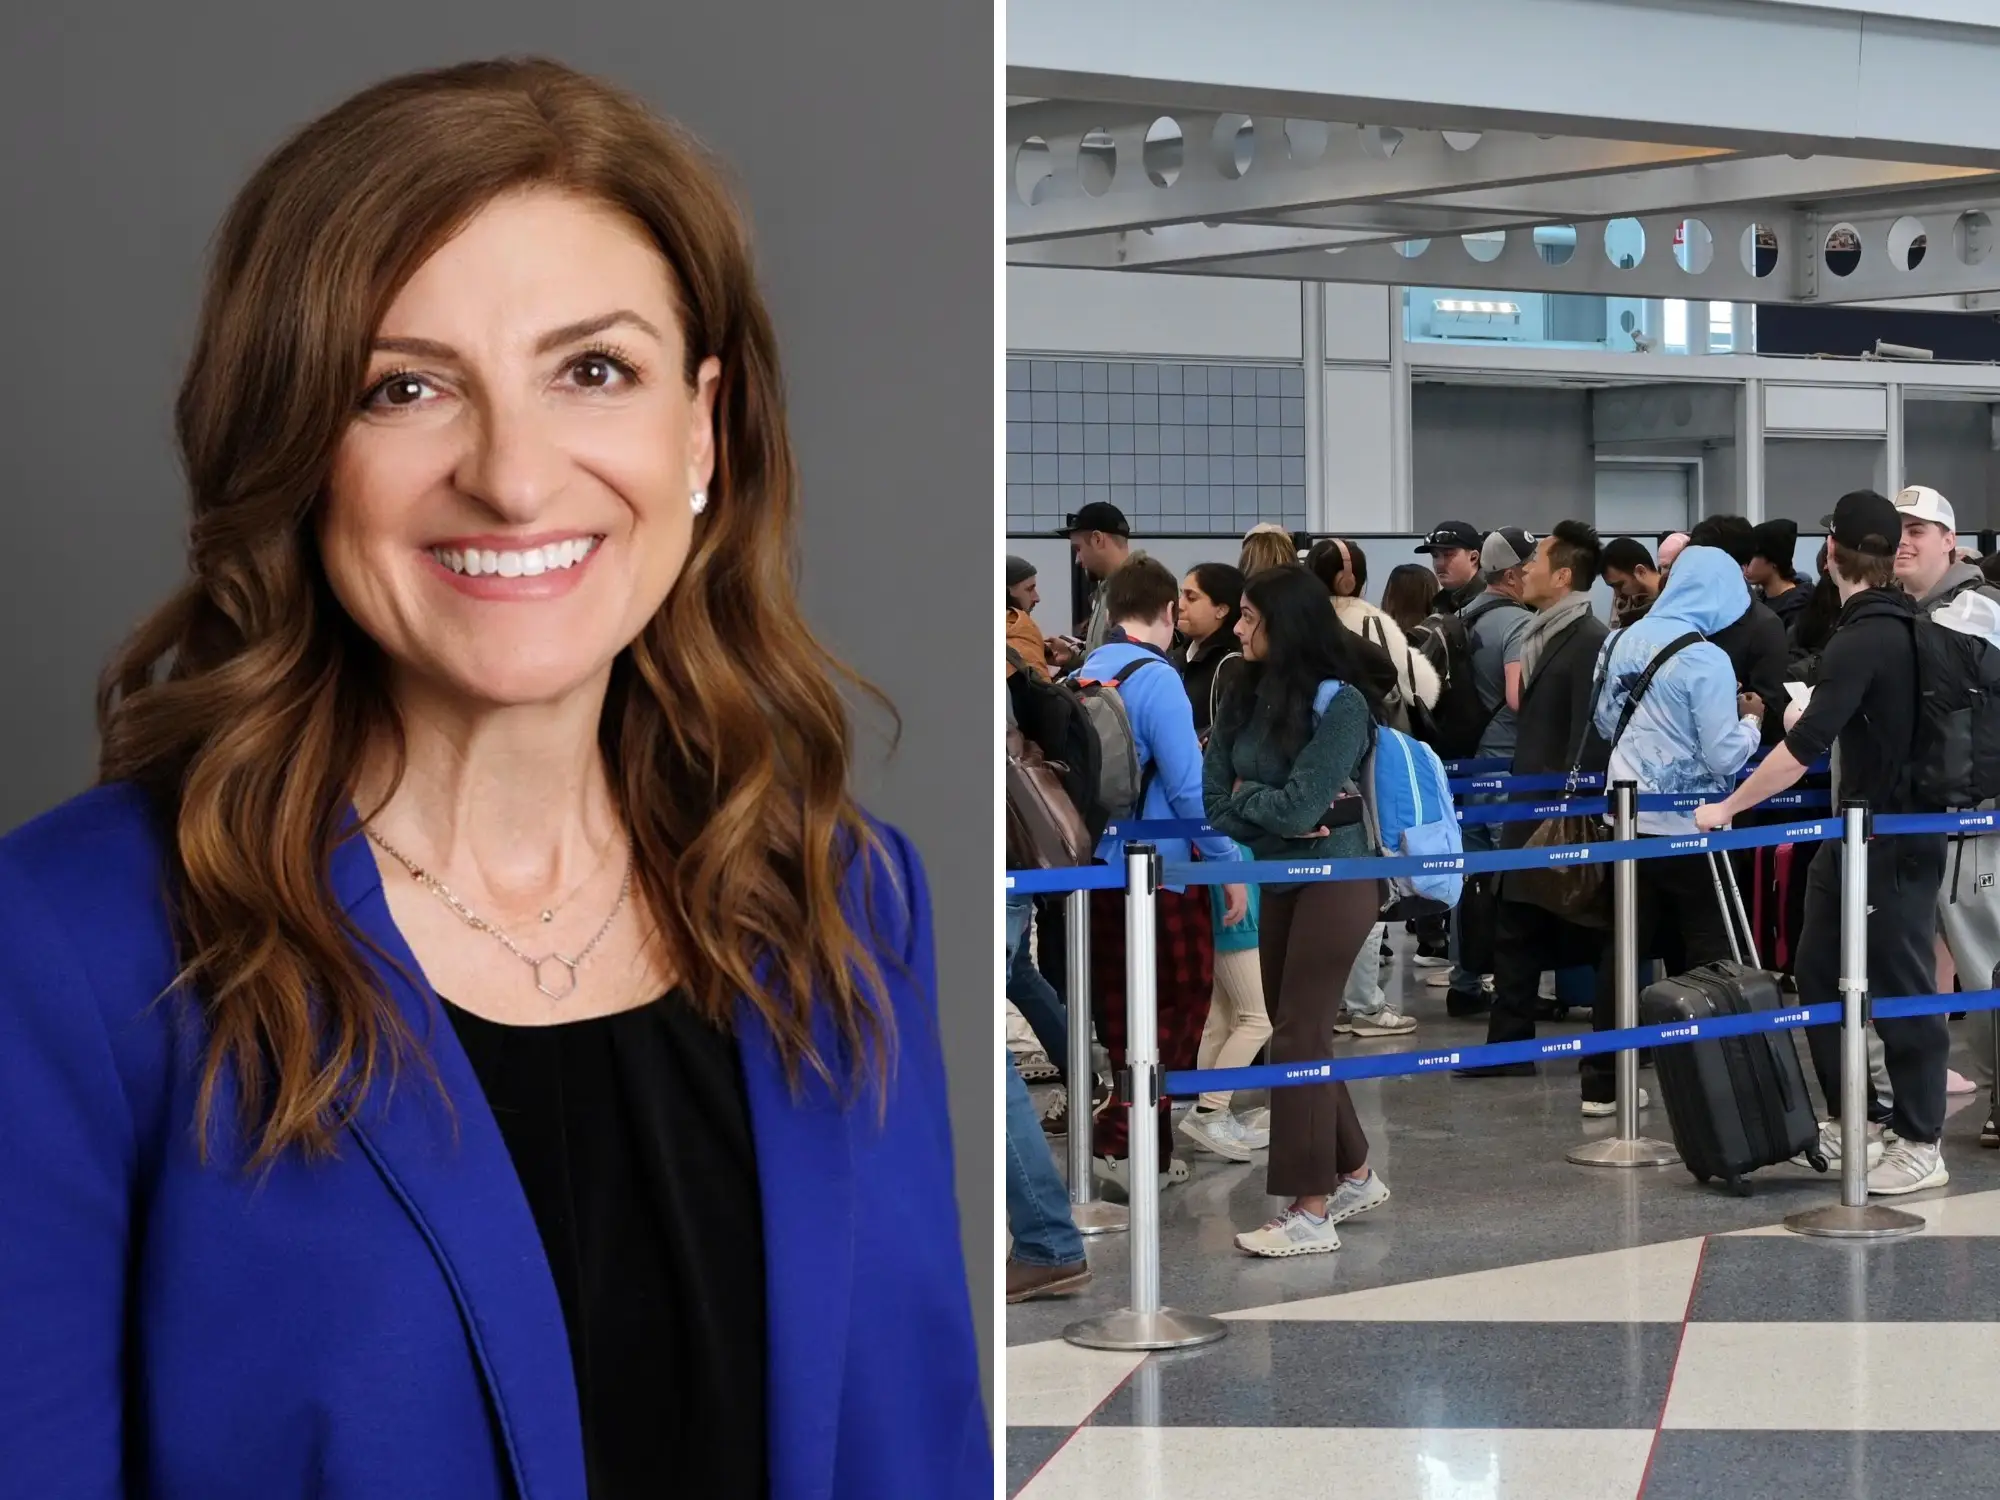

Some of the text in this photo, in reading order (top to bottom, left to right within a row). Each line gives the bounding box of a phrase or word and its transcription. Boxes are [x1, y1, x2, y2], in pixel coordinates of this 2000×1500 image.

[1533, 805, 1560, 813] UNITED
[1959, 818, 1986, 826] UNITED
[1786, 828, 1814, 837] UNITED
[1670, 840, 1700, 849] UNITED
[1549, 851, 1580, 860] UNITED
[1422, 860, 1455, 869] UNITED
[1287, 867, 1322, 875] UNITED
[1773, 1014, 1802, 1024] UNITED
[1660, 1028, 1690, 1038] UNITED
[1541, 1043, 1572, 1053] UNITED
[1418, 1056, 1450, 1066] UNITED
[1286, 1068, 1320, 1078] UNITED
